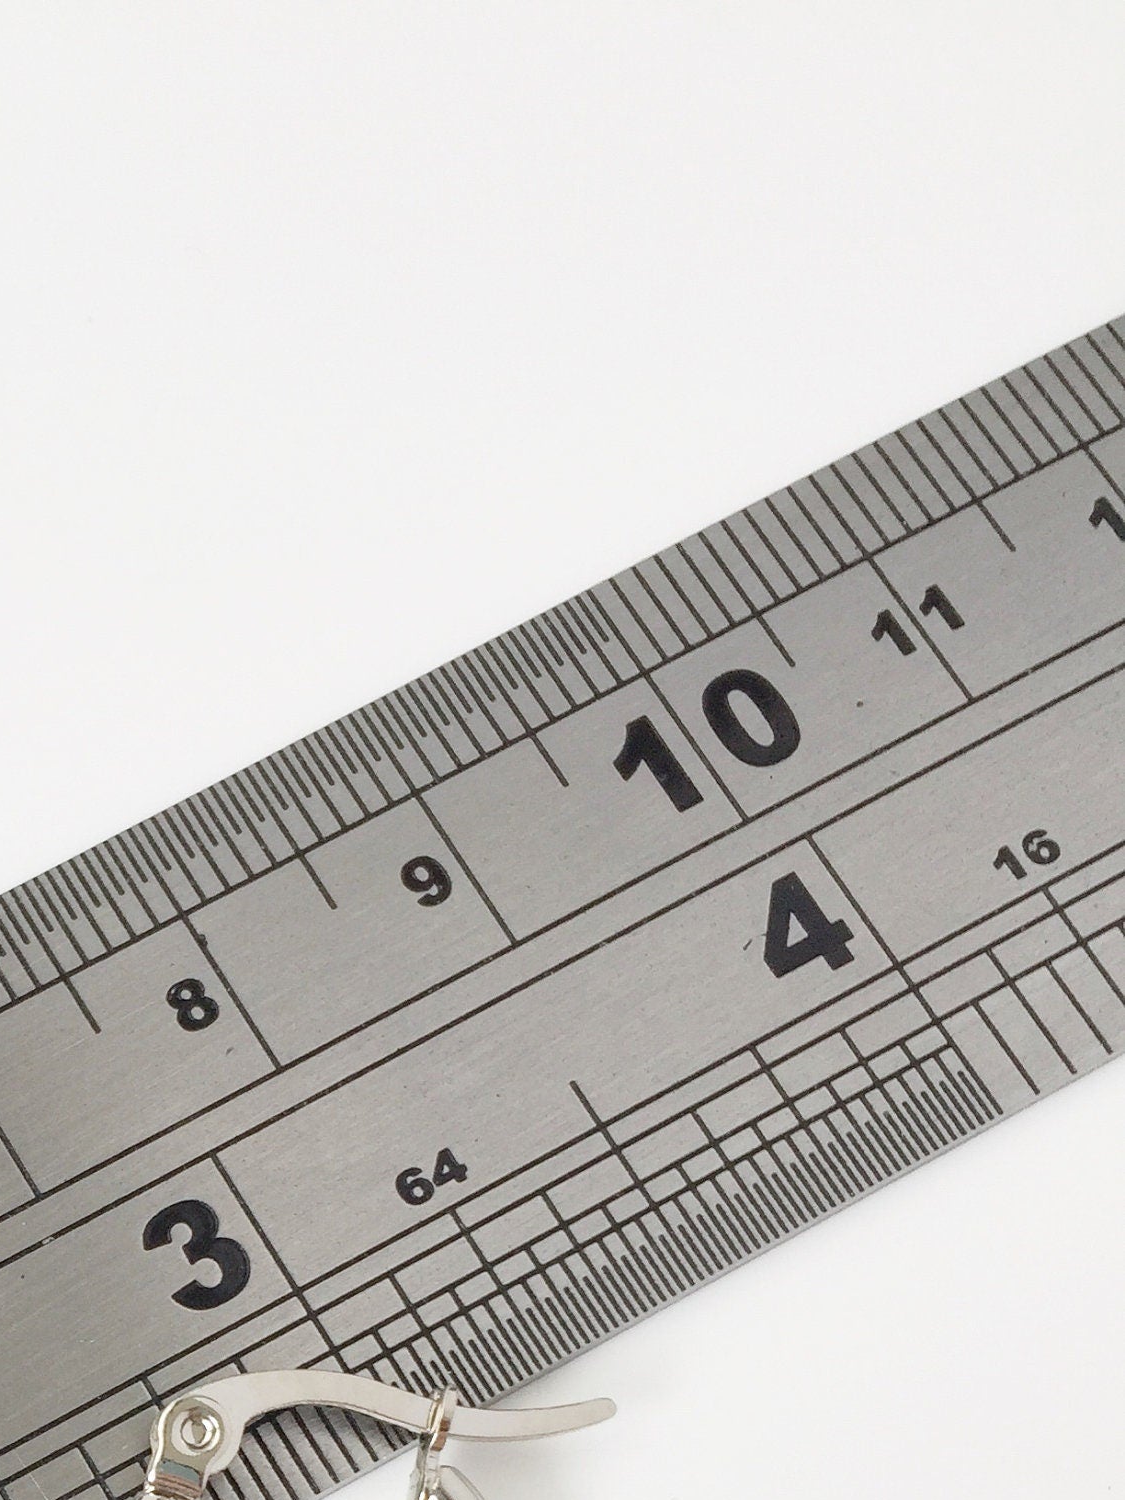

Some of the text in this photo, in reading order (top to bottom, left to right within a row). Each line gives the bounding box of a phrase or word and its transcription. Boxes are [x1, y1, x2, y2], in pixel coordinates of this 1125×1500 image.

[871, 584, 965, 656] 11
[613, 667, 801, 812] 10
[401, 855, 452, 907] 9
[992, 829, 1061, 880] 16
[763, 871, 855, 978] 4
[167, 978, 219, 1031] 8
[395, 1148, 468, 1205] 64
[142, 1199, 251, 1310] 3
